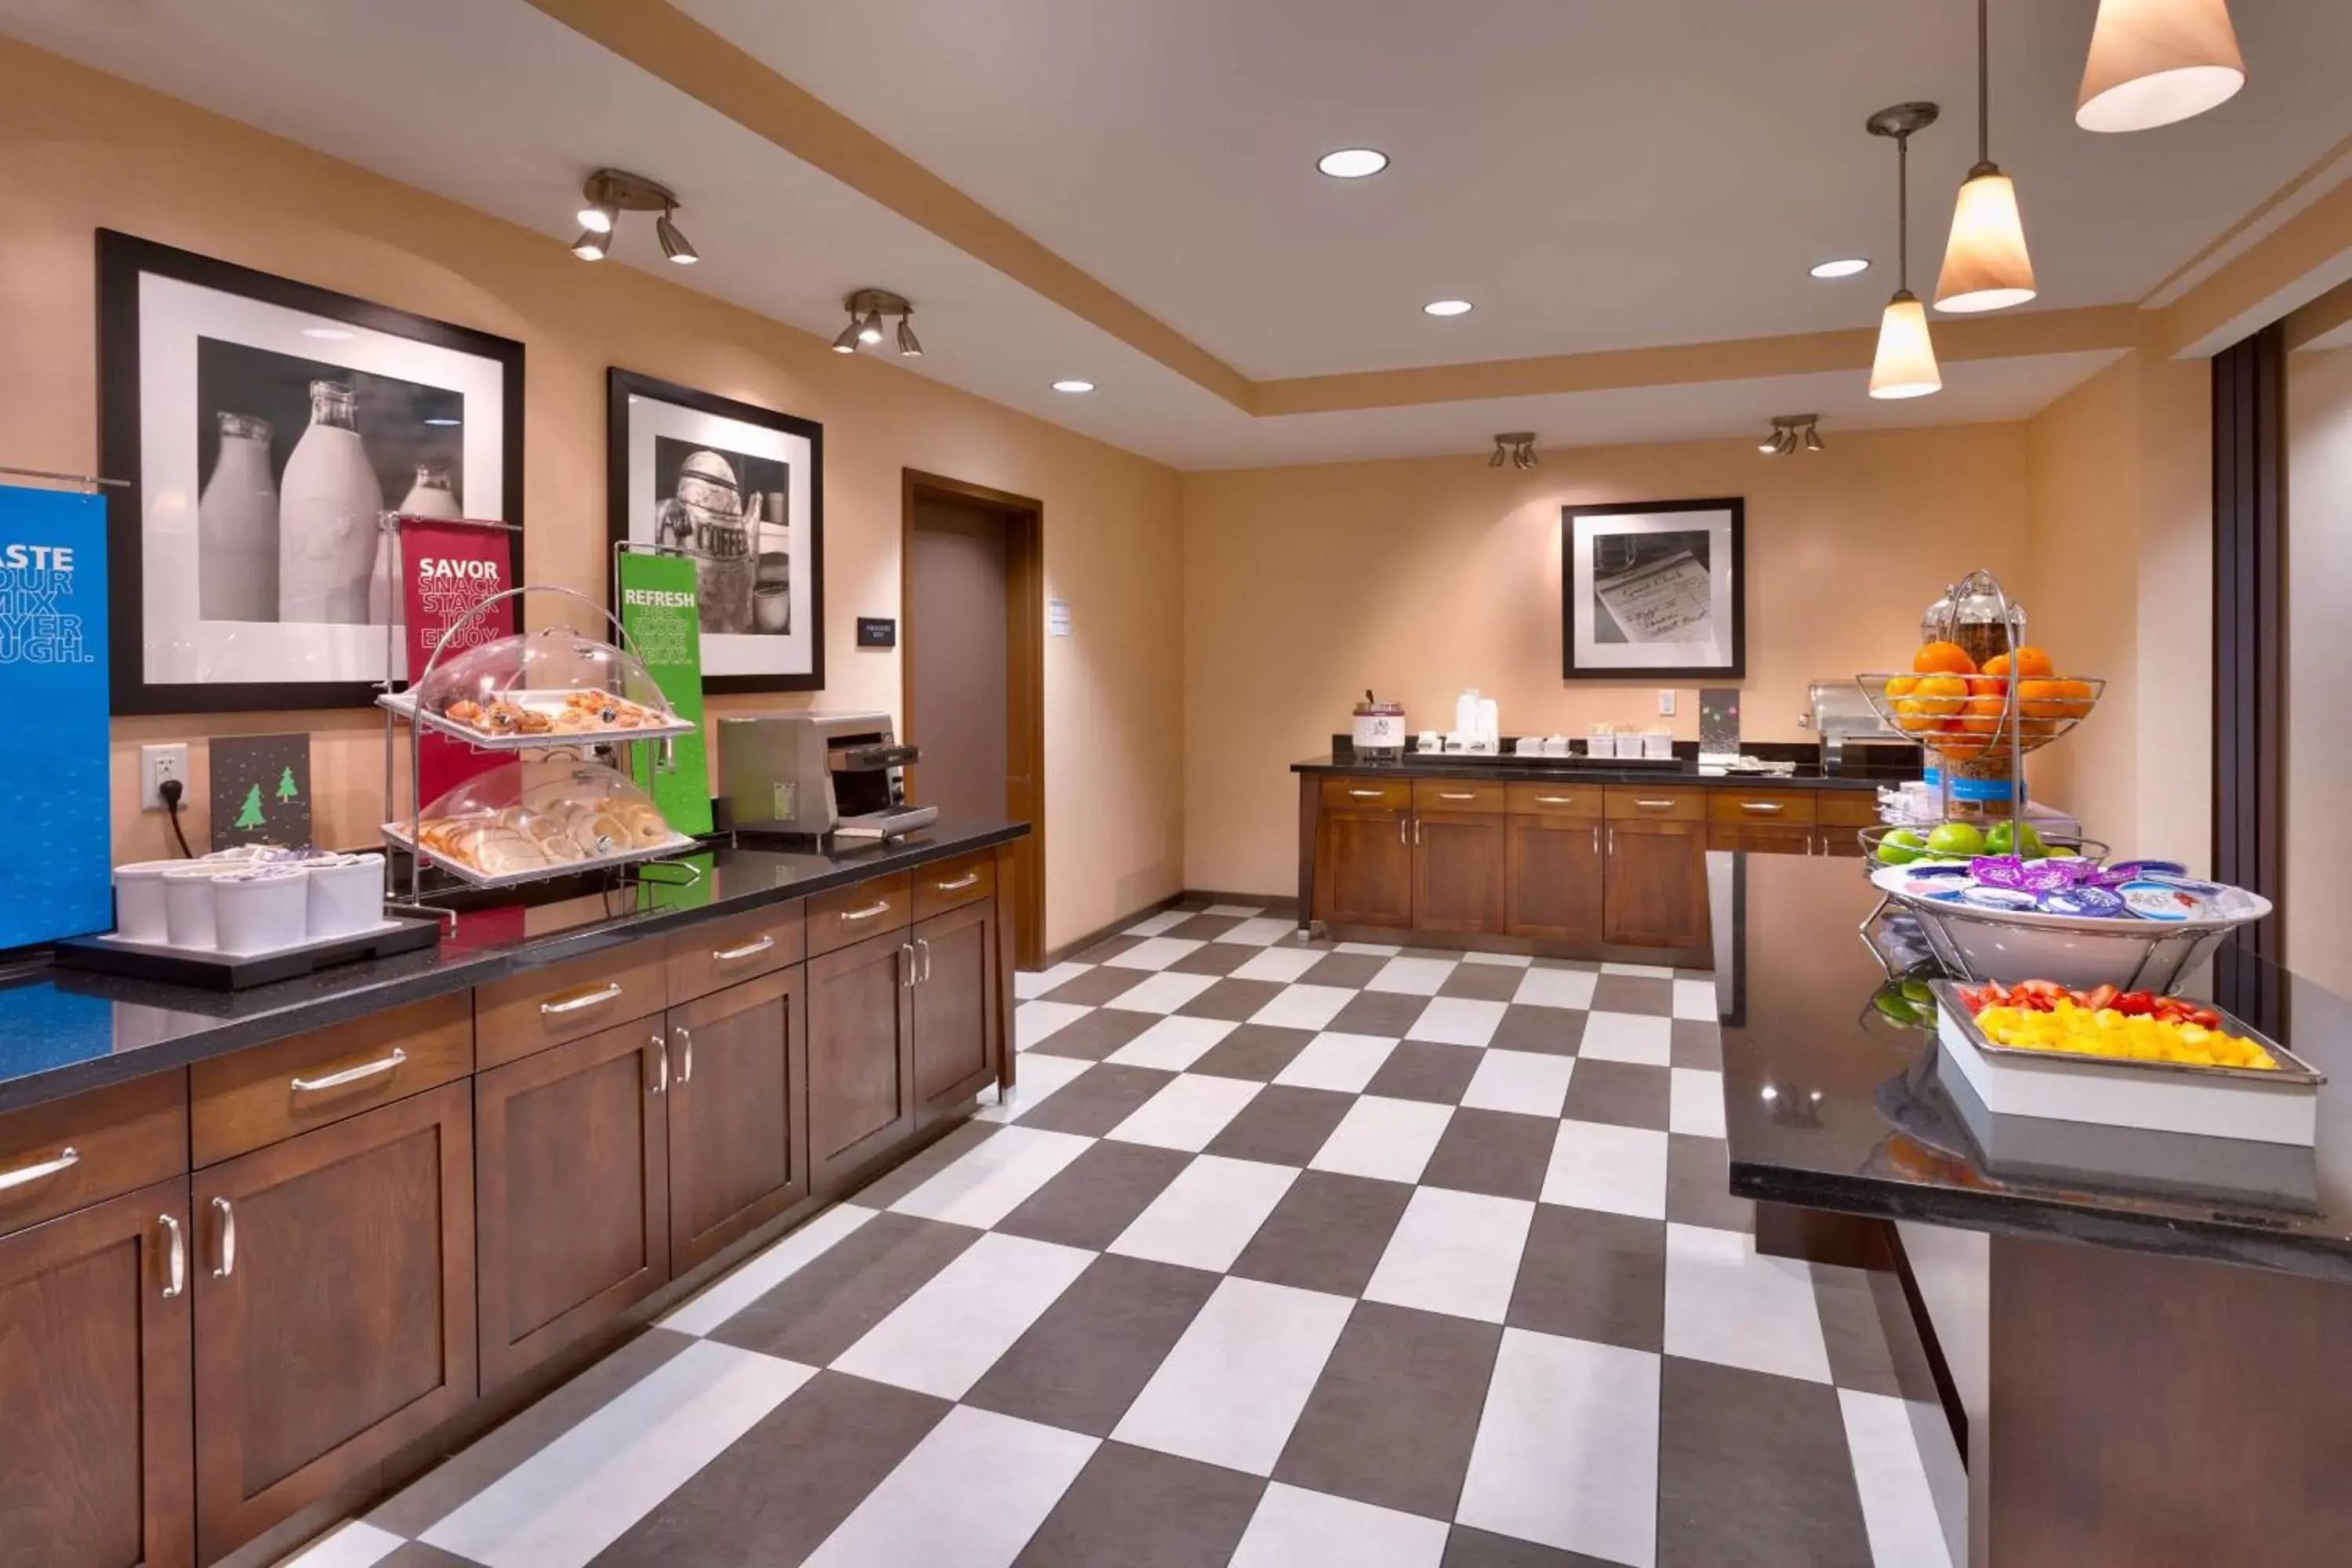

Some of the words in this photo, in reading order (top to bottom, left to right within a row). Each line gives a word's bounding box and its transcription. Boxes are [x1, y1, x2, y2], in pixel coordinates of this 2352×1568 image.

[0, 544, 74, 572] STE
[419, 557, 498, 579] SAVOR
[418, 576, 501, 595] SNACK
[624, 589, 695, 608] REFRESH
